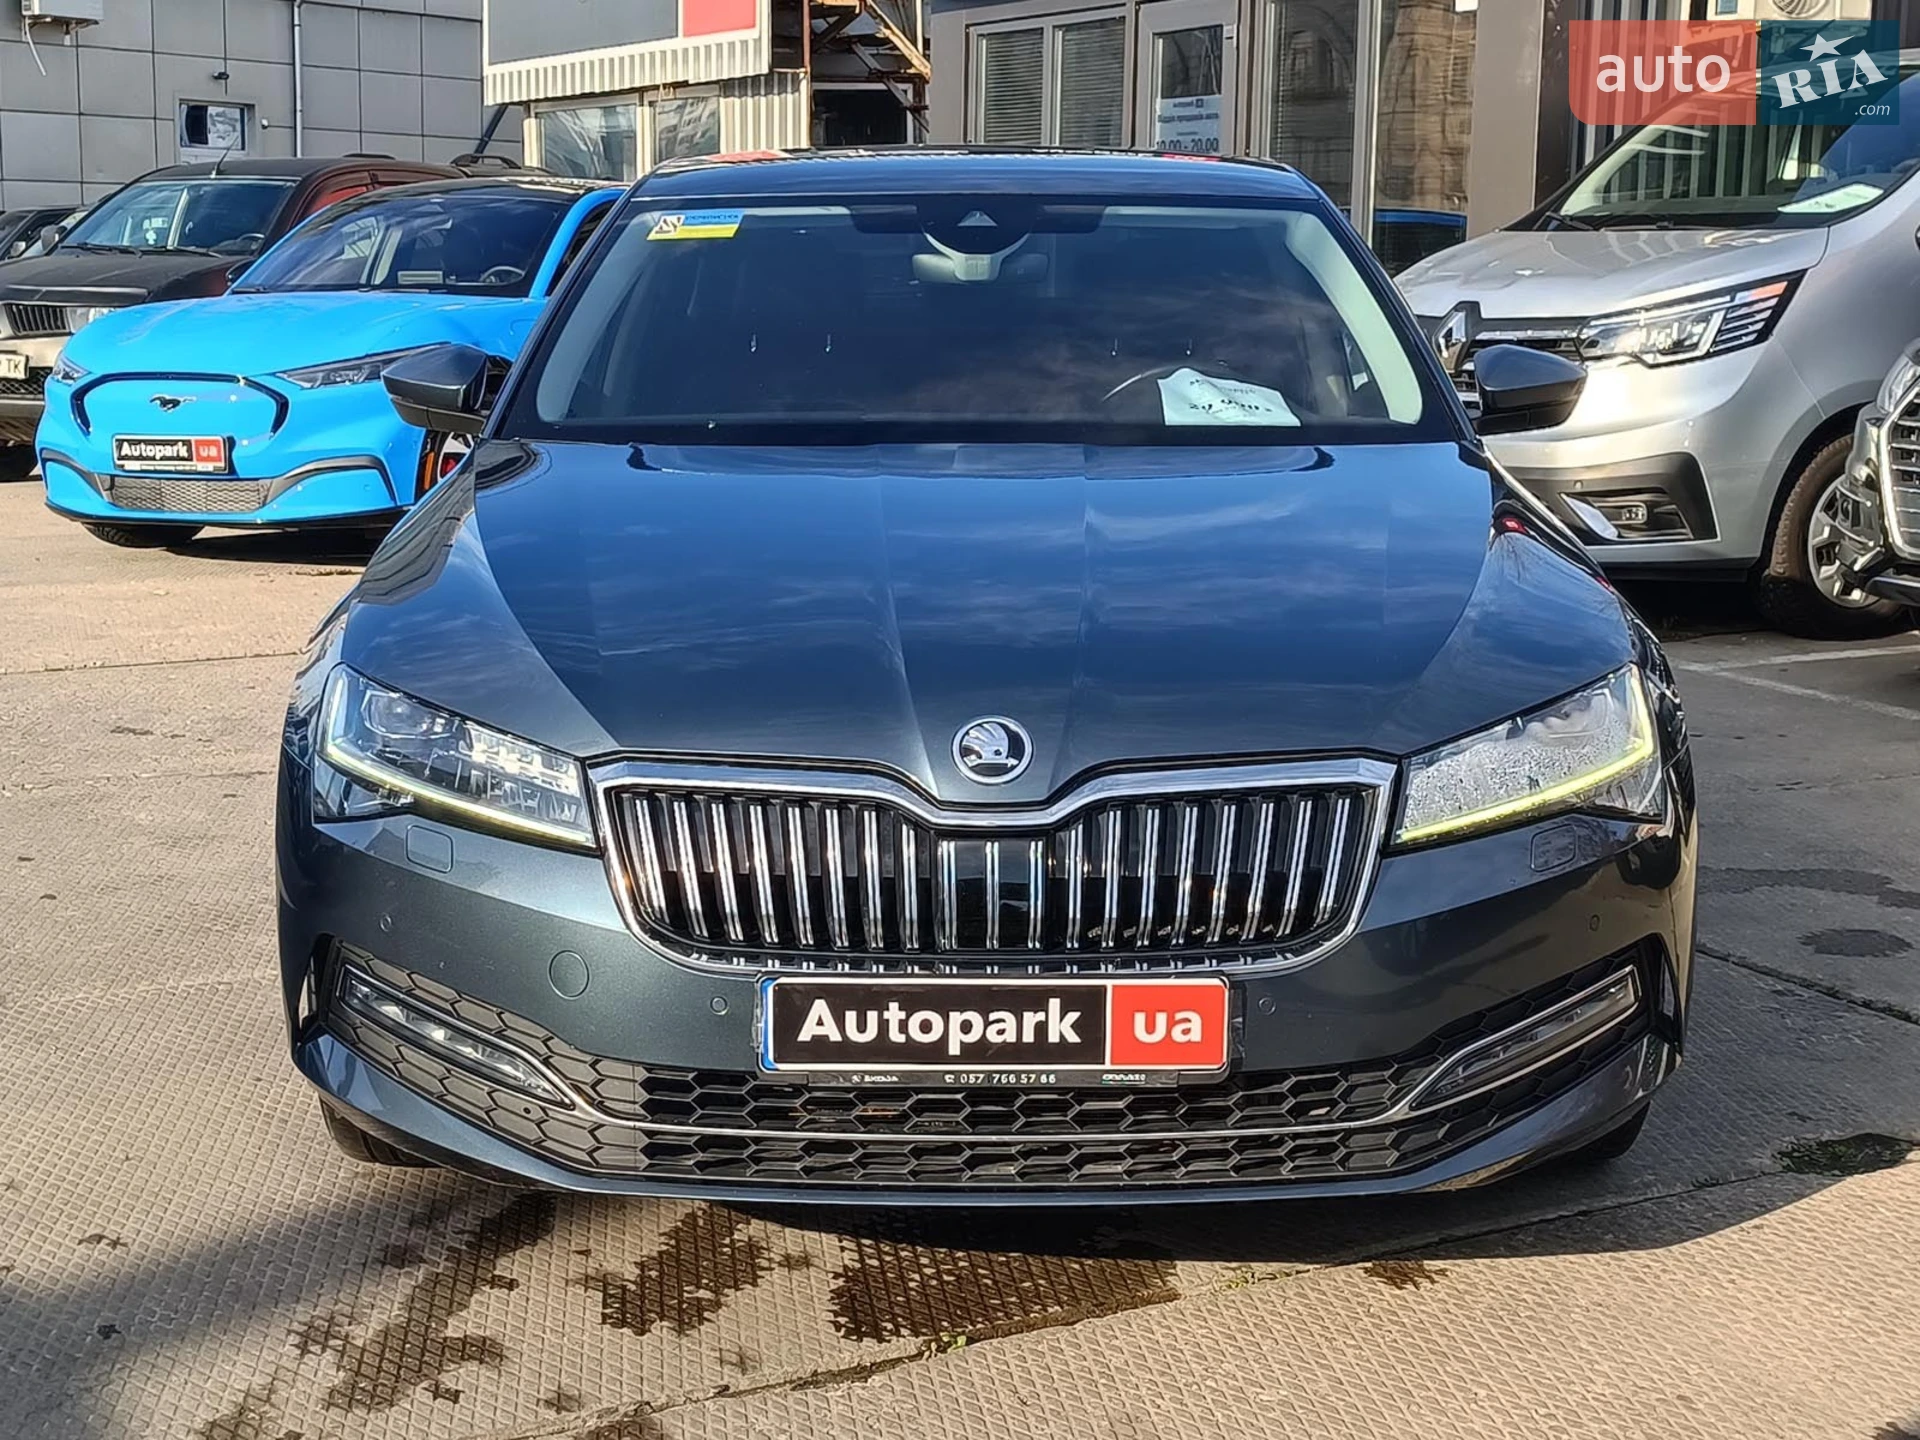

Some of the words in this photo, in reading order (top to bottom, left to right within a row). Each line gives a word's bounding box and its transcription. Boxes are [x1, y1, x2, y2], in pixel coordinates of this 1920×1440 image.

[120, 441, 189, 460] Autopark
[198, 445, 218, 457] ua
[797, 997, 1081, 1056] Autopark
[1132, 1009, 1203, 1044] ua
[960, 1073, 985, 1084] 057
[992, 1073, 1017, 1084] 766
[1020, 1073, 1036, 1084] 57
